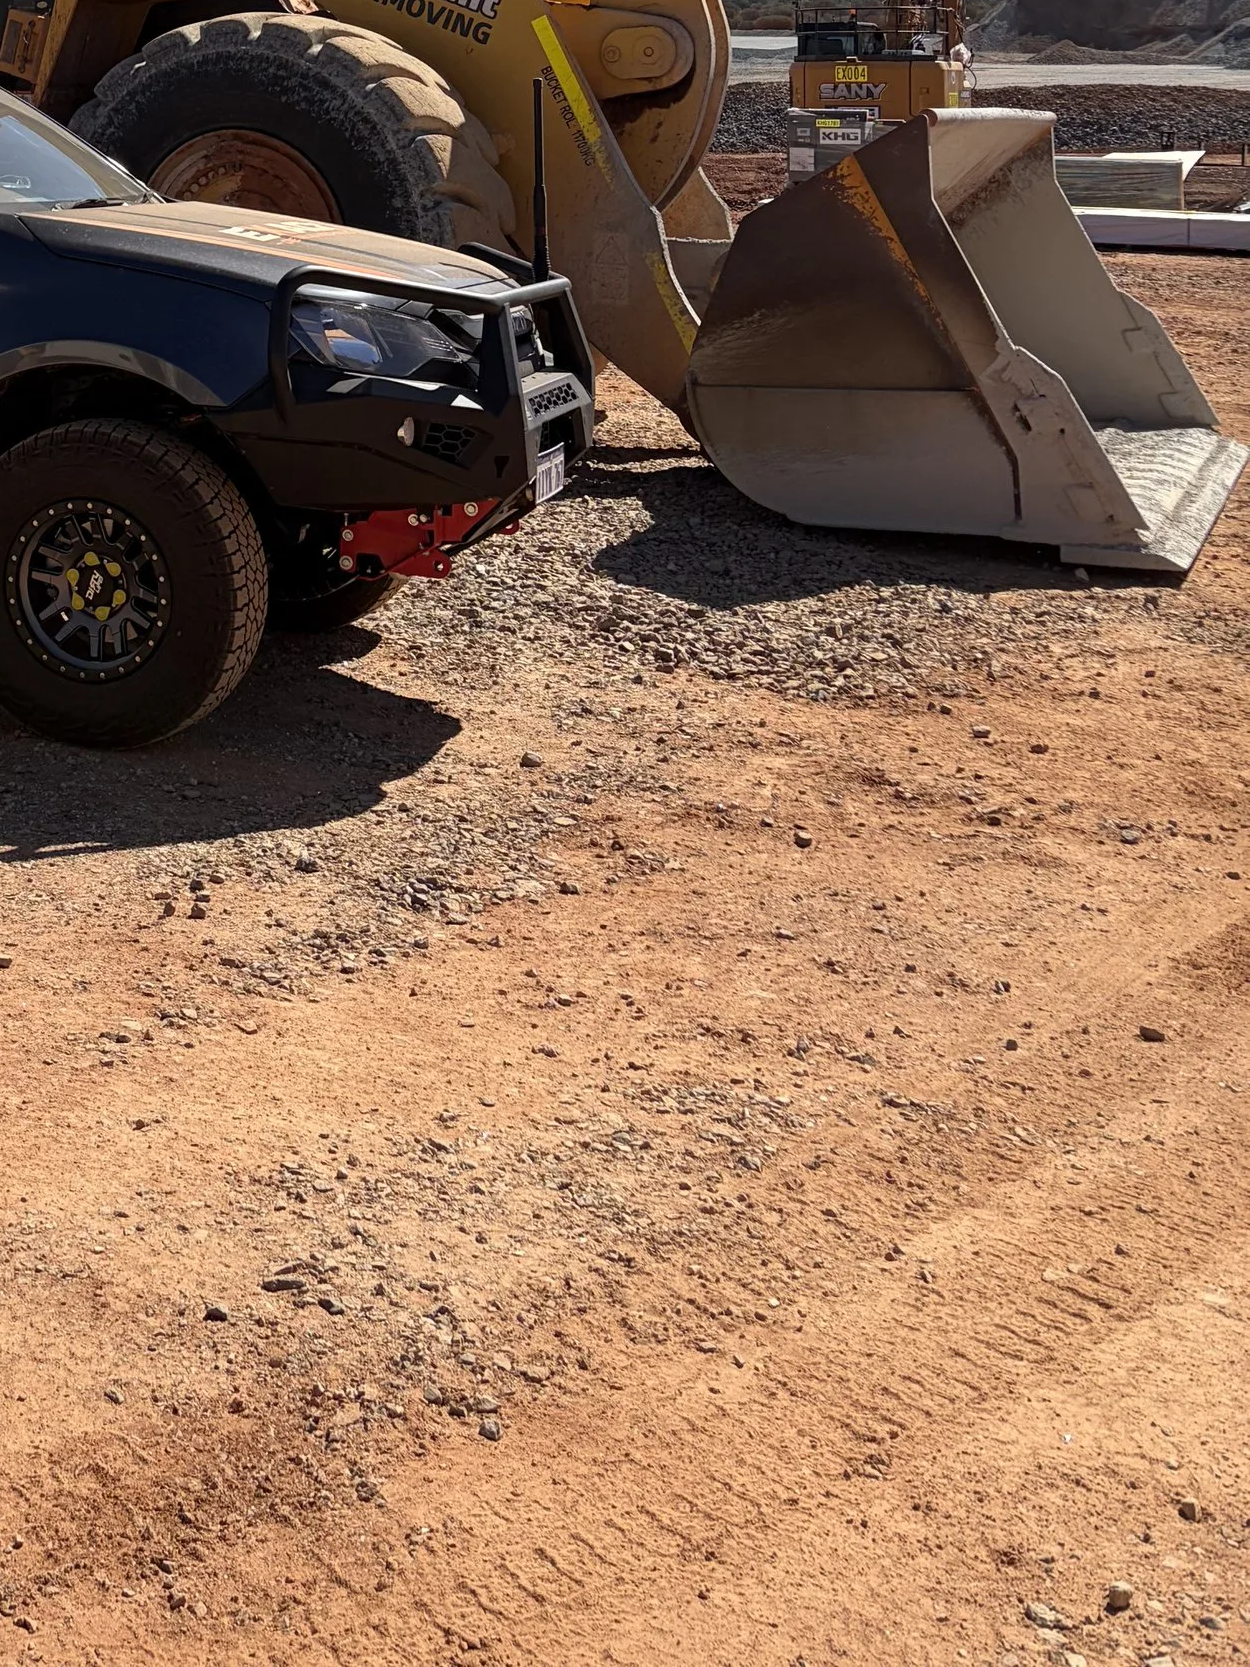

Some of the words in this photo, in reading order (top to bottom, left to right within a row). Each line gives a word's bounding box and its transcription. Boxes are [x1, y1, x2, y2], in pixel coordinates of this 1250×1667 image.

[836, 66, 866, 81] EX004
[541, 66, 568, 104] BUCKET
[819, 82, 887, 101] SANY
[821, 131, 859, 141] KHG
